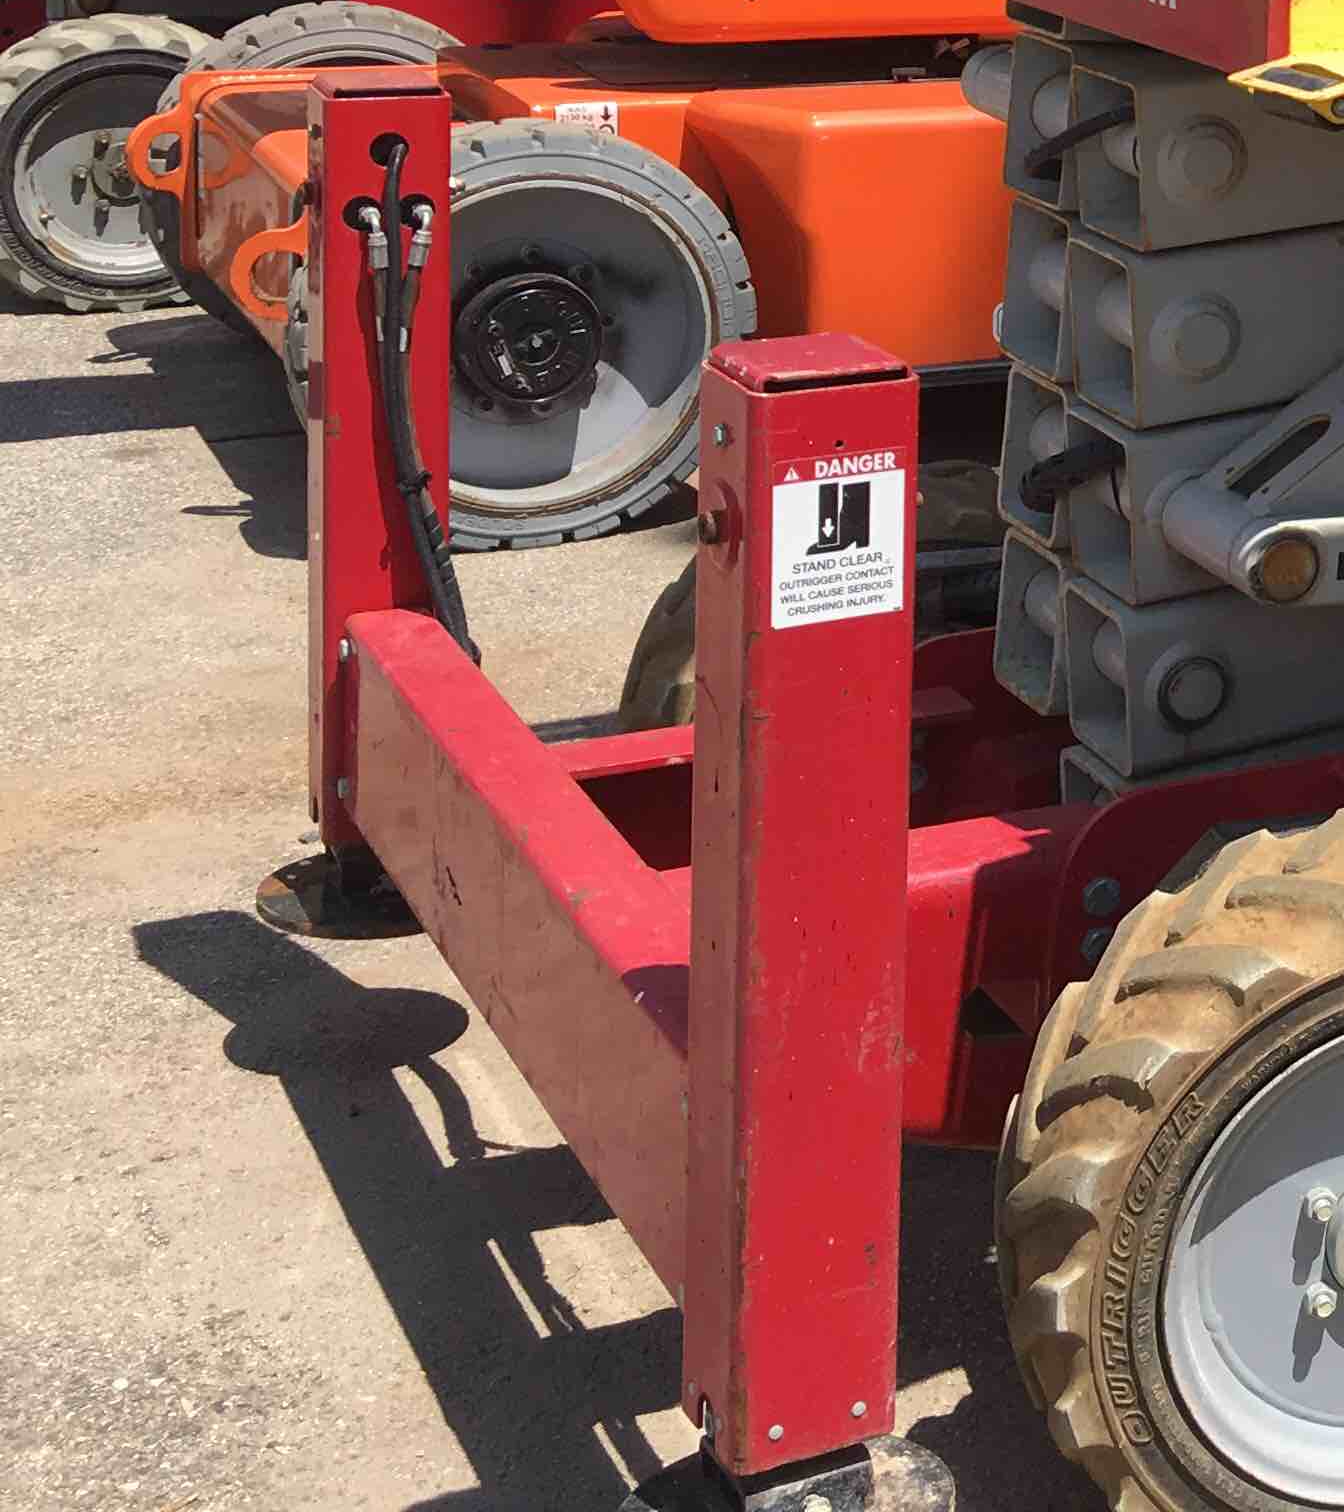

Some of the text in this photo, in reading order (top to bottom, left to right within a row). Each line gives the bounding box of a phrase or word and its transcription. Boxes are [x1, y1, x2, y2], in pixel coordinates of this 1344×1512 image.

[814, 451, 897, 479] DANGER
[792, 551, 883, 575] STAND CLEAR
[779, 565, 895, 591] OUTRIGGER CONTACT
[780, 579, 894, 605] WILL CAUSE SERIOUS
[787, 601, 844, 617] CRUSHING
